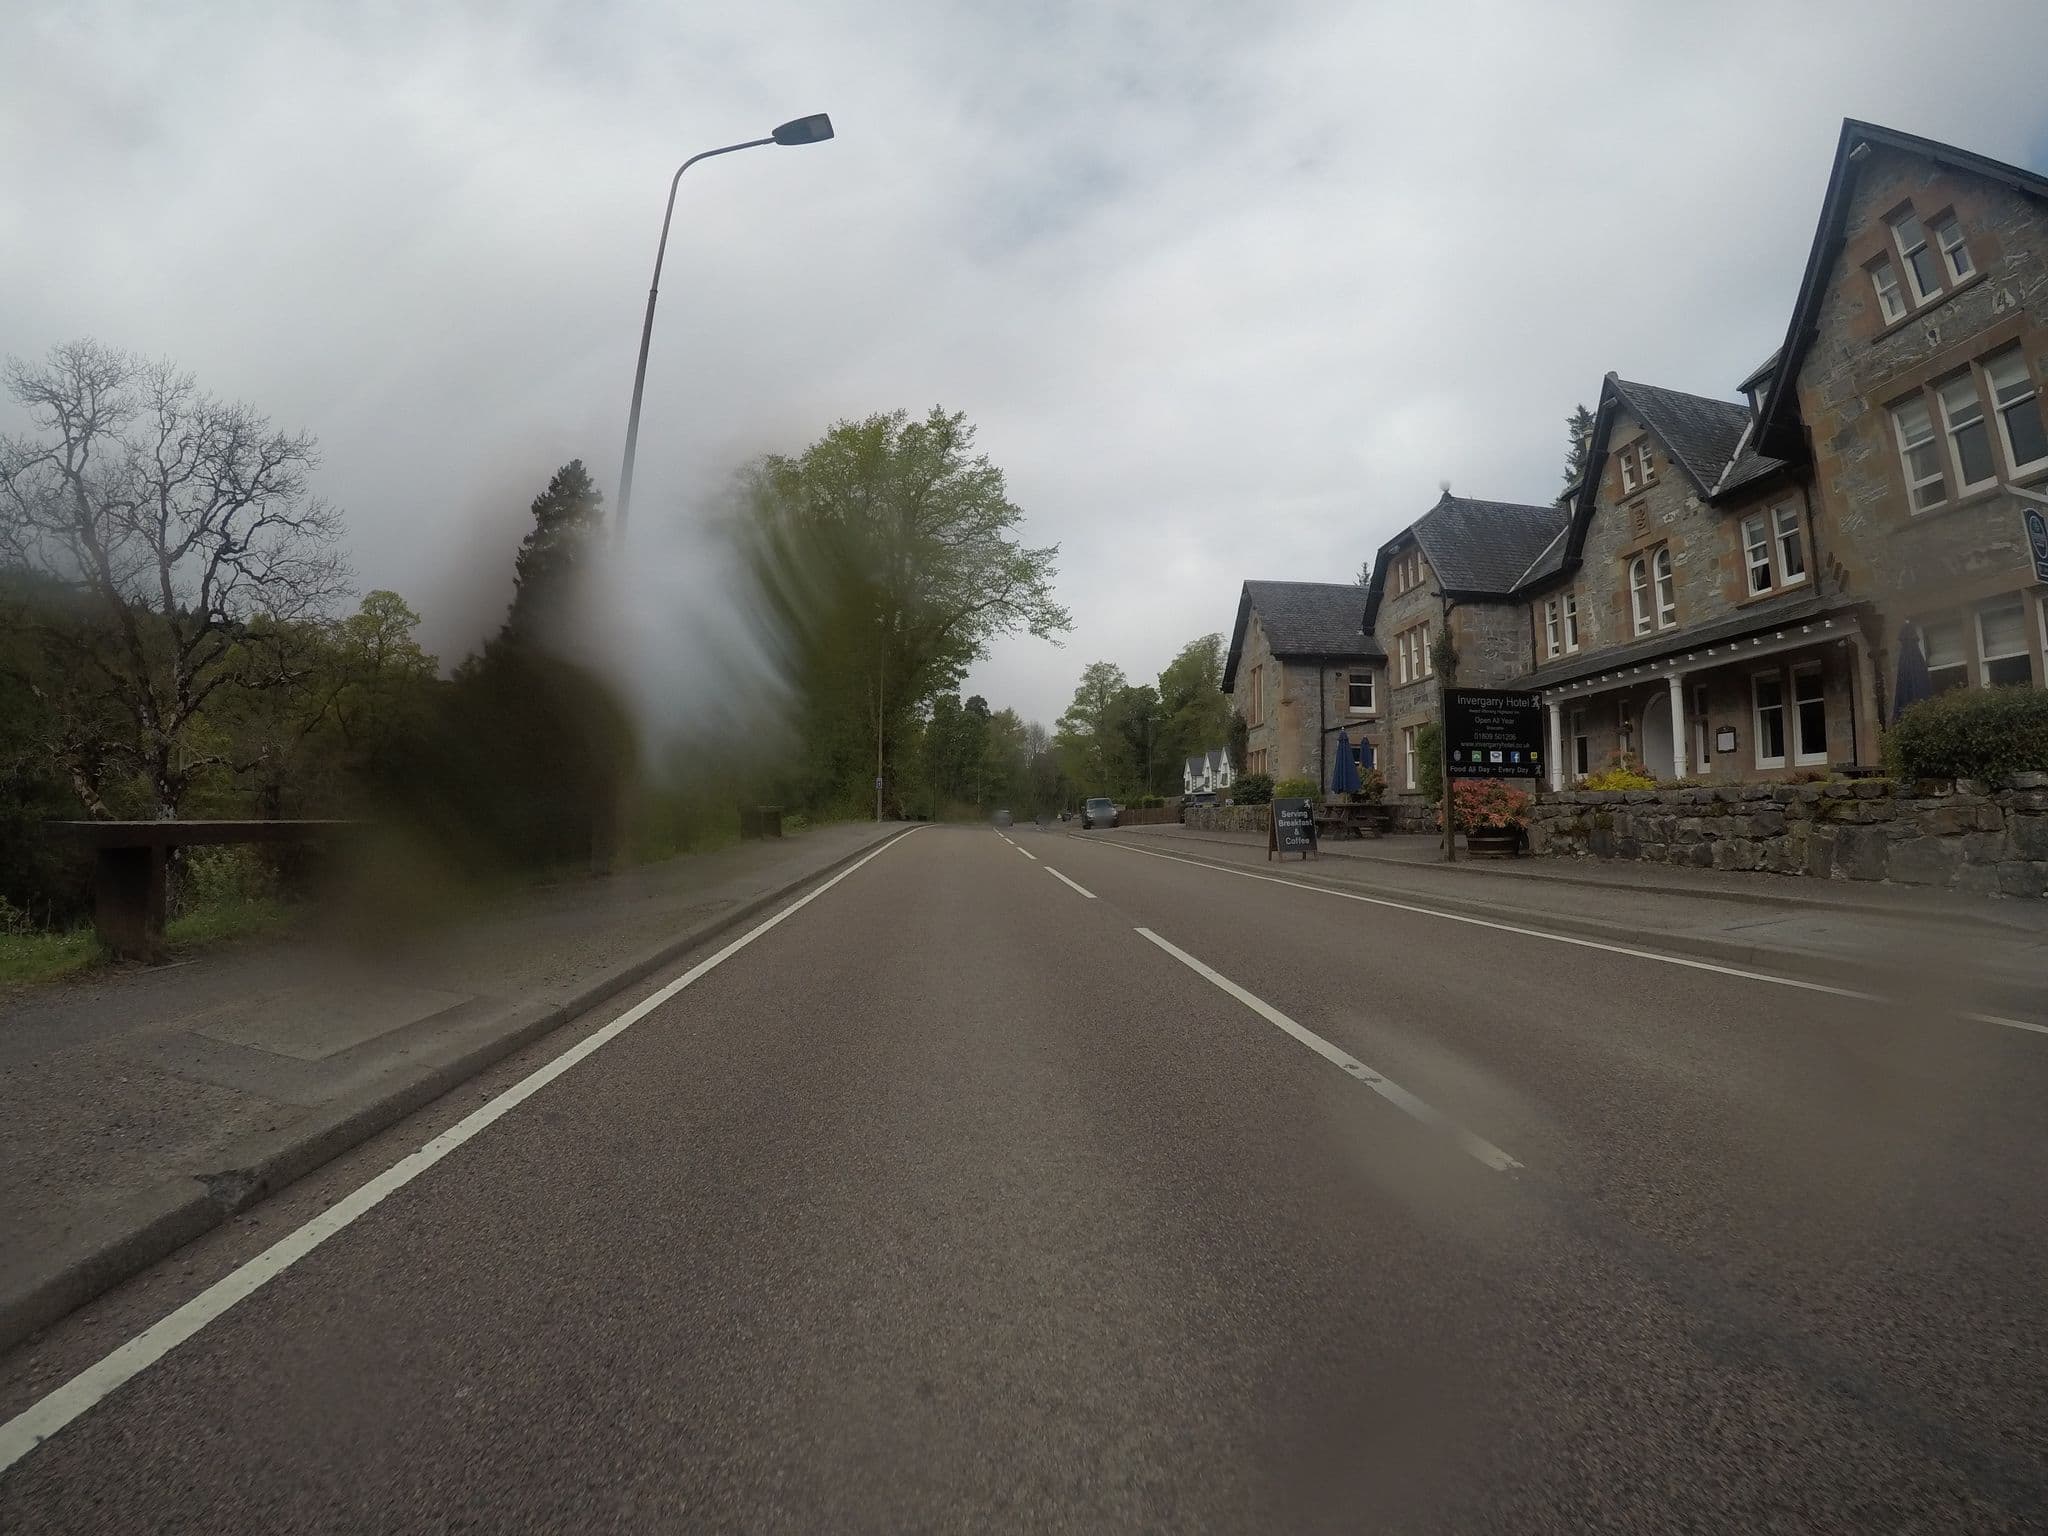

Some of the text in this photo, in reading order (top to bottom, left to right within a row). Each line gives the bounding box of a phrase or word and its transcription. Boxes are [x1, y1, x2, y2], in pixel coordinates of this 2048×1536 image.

[1457, 695, 1530, 708] Invergarry Hotel
[1478, 766, 1490, 774] Day
[1498, 766, 1516, 774] Every
[1281, 810, 1308, 818] Serving
[1278, 819, 1313, 827] Breakfast
[1285, 837, 1310, 845] Coffee
